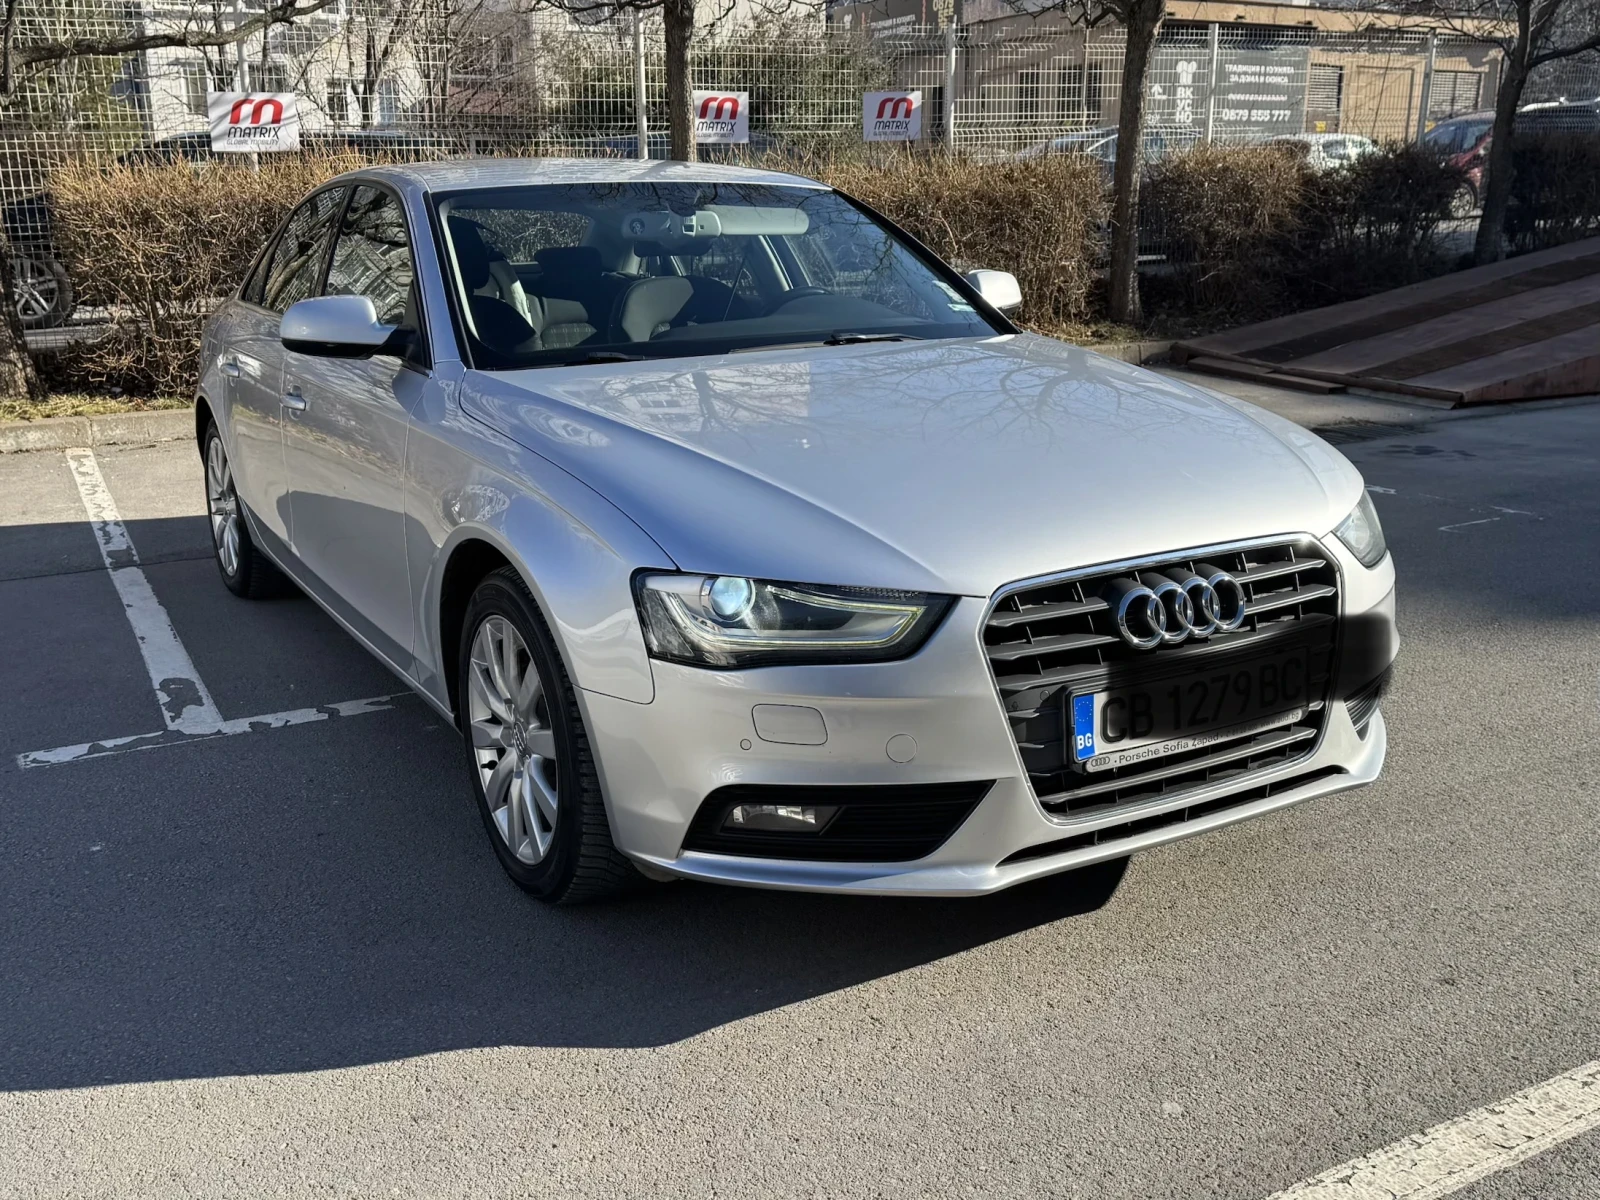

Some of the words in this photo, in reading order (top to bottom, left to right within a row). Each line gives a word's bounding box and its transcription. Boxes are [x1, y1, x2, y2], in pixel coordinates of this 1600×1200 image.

[1177, 86, 1193, 99] ВК
[1176, 99, 1192, 111] УС
[1175, 111, 1193, 123] НО
[1222, 108, 1249, 121] 0879
[1250, 109, 1270, 121] 555
[1271, 109, 1291, 122] 777
[696, 121, 737, 133] MATRIX
[874, 120, 910, 131] MATRIX
[227, 126, 281, 139] MATRIX
[1077, 732, 1093, 750] BG
[1118, 747, 1160, 764] Porsche
[1163, 741, 1189, 754] Sofia
[1191, 732, 1219, 748] Zapad
